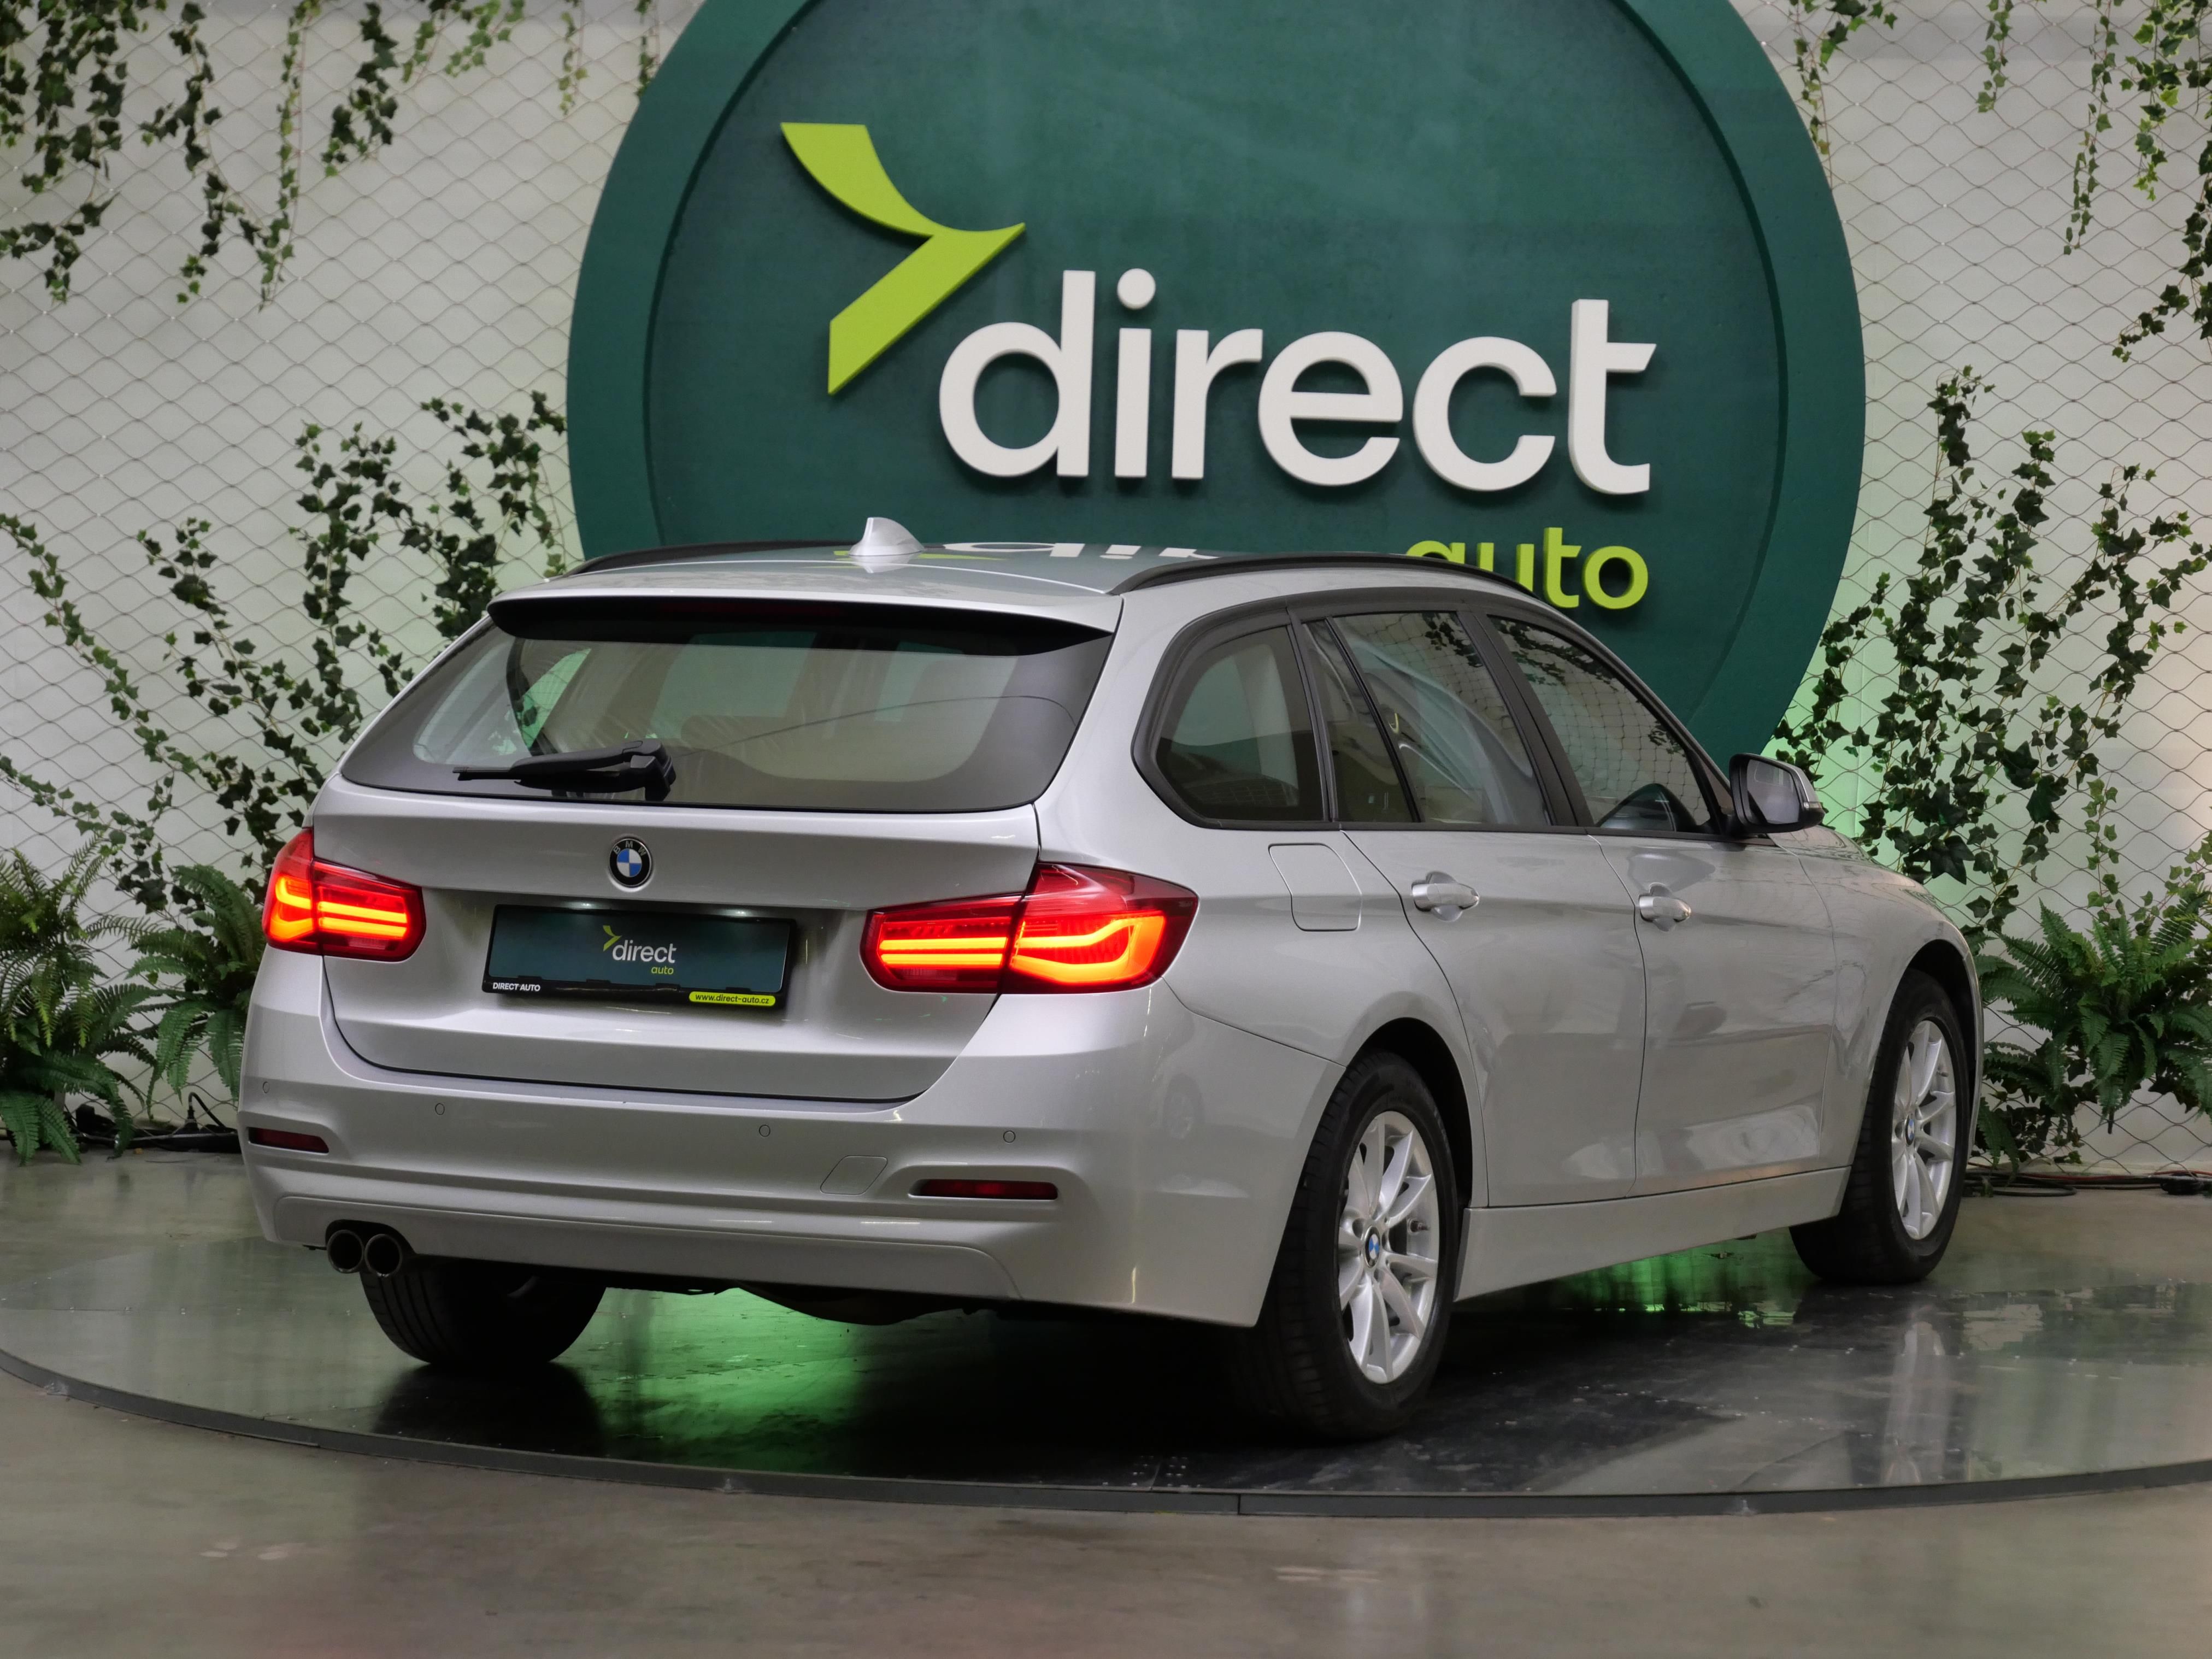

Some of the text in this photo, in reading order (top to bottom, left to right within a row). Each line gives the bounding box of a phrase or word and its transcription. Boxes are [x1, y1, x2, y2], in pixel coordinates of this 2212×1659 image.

[939, 268, 1657, 495] direct
[613, 840, 647, 856] BMW
[612, 939, 677, 963] direct
[651, 966, 674, 974] auto
[493, 982, 541, 992] DIRECT AUTO
[695, 994, 769, 1004] www.direct-auto.cz
